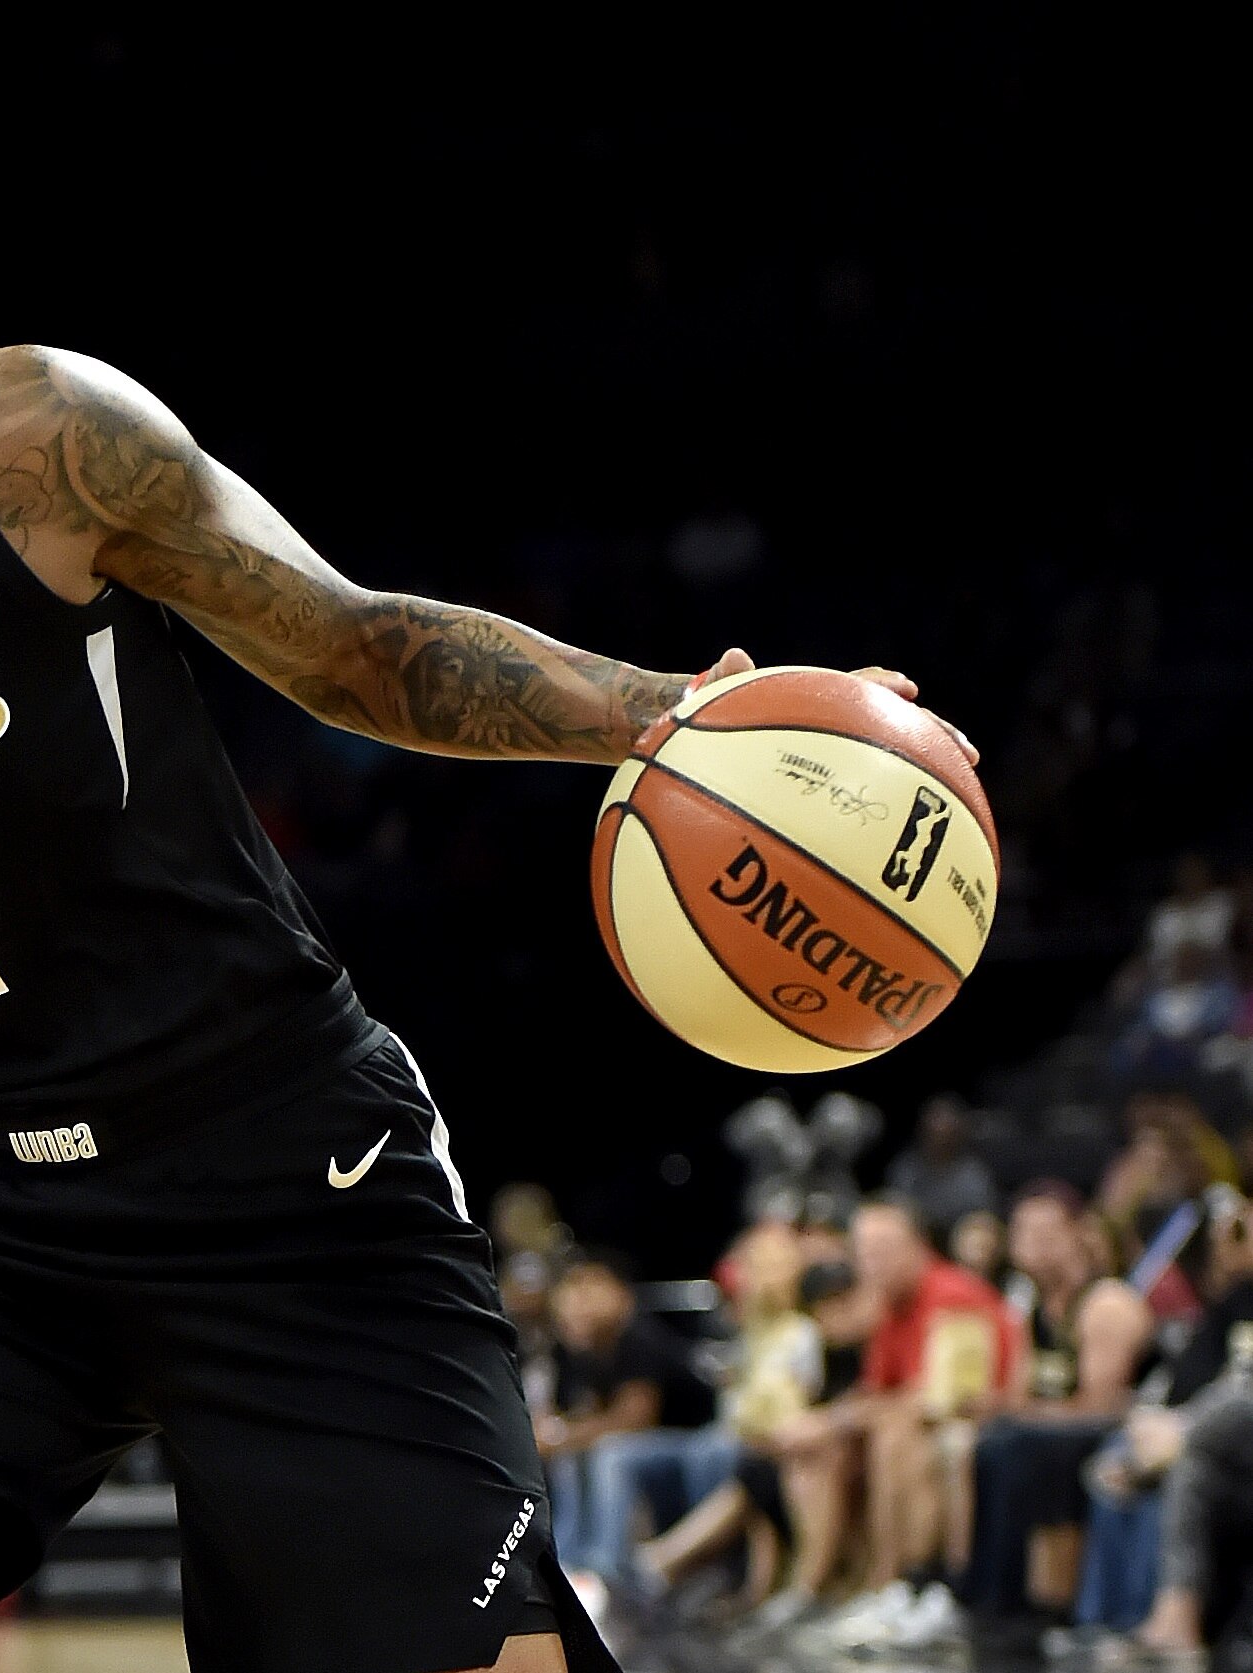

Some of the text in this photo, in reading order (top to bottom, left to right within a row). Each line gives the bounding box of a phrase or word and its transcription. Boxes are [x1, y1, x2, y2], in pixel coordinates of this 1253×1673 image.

[708, 843, 944, 1030] SPALDING
[472, 1498, 535, 1609] LAS VEGAS
